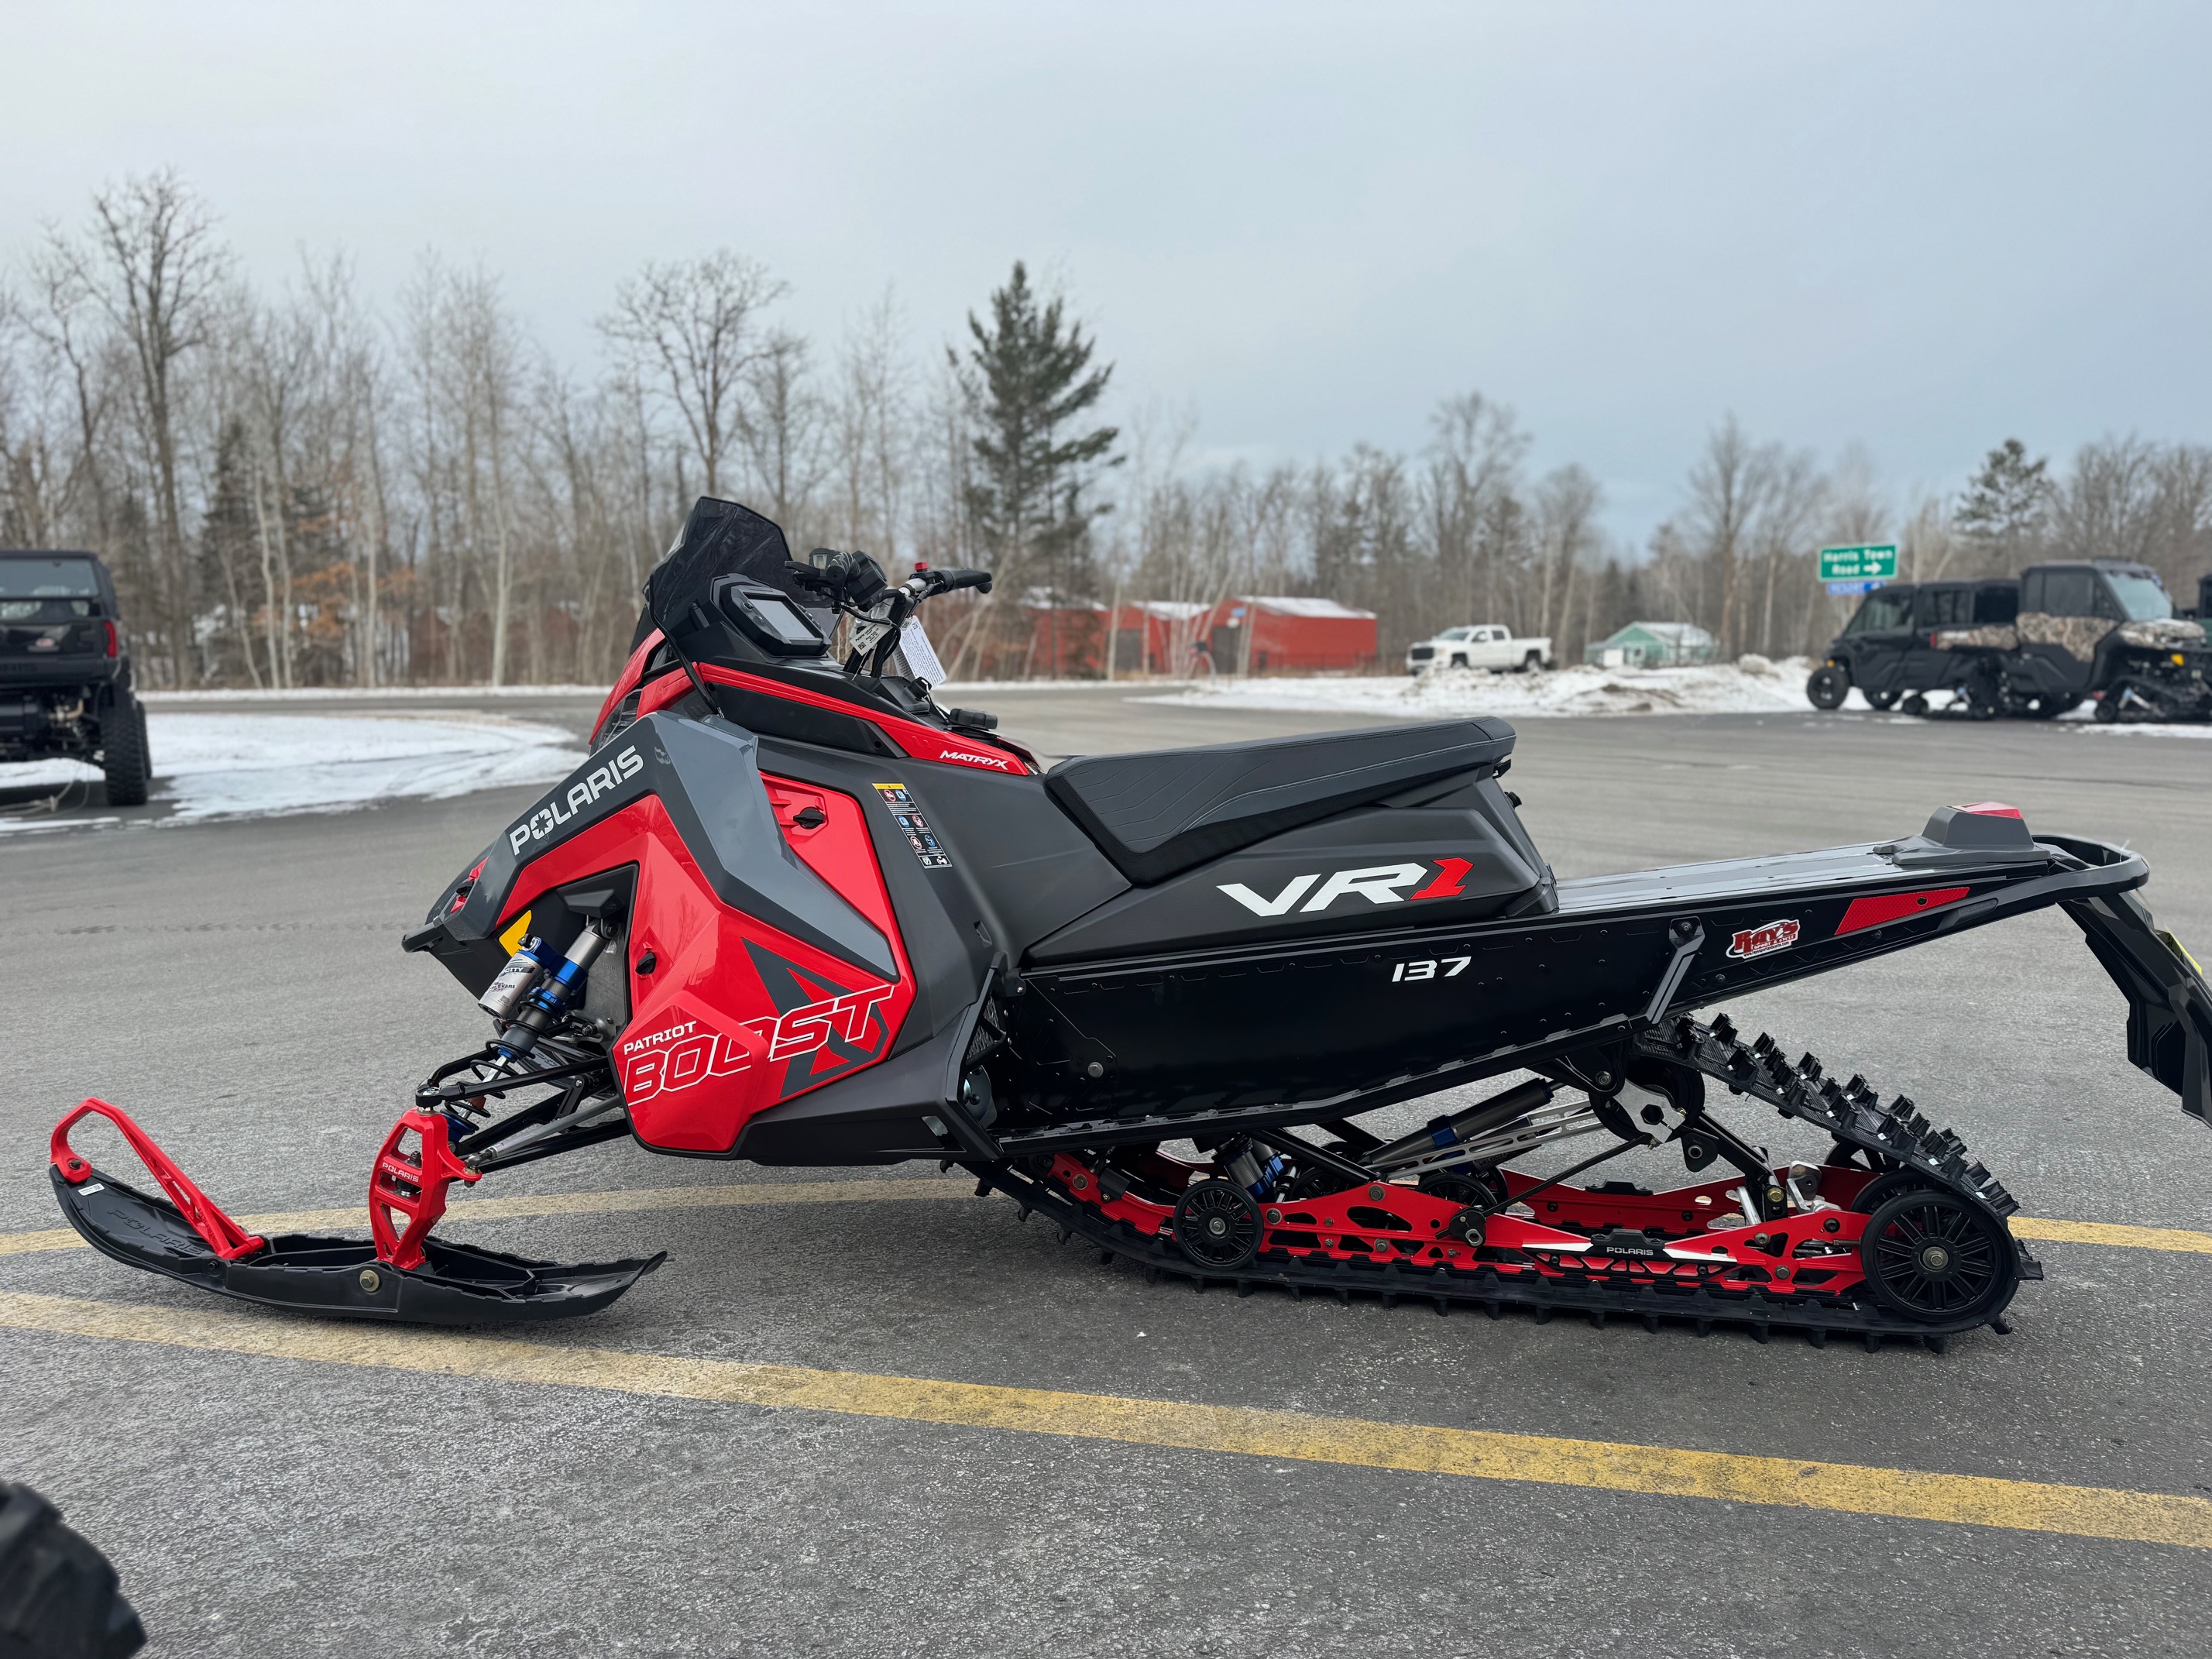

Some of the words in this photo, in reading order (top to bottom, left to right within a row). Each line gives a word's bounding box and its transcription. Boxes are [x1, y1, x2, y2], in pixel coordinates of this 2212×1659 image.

[1863, 549, 1893, 561] Town
[1832, 564, 1860, 575] Road
[939, 750, 1008, 771] MATRYX
[510, 745, 644, 856] POLARIS
[1216, 857, 1474, 917] VR1
[1392, 957, 1472, 982] 137
[623, 1021, 697, 1056] PATRIOT
[623, 984, 895, 1106] BOOST
[1479, 1152, 1508, 1166] VELOCIT
[382, 1162, 419, 1183] POLARIS
[107, 1208, 206, 1255] POLARIS
[1606, 1247, 1654, 1255] POLARIS
